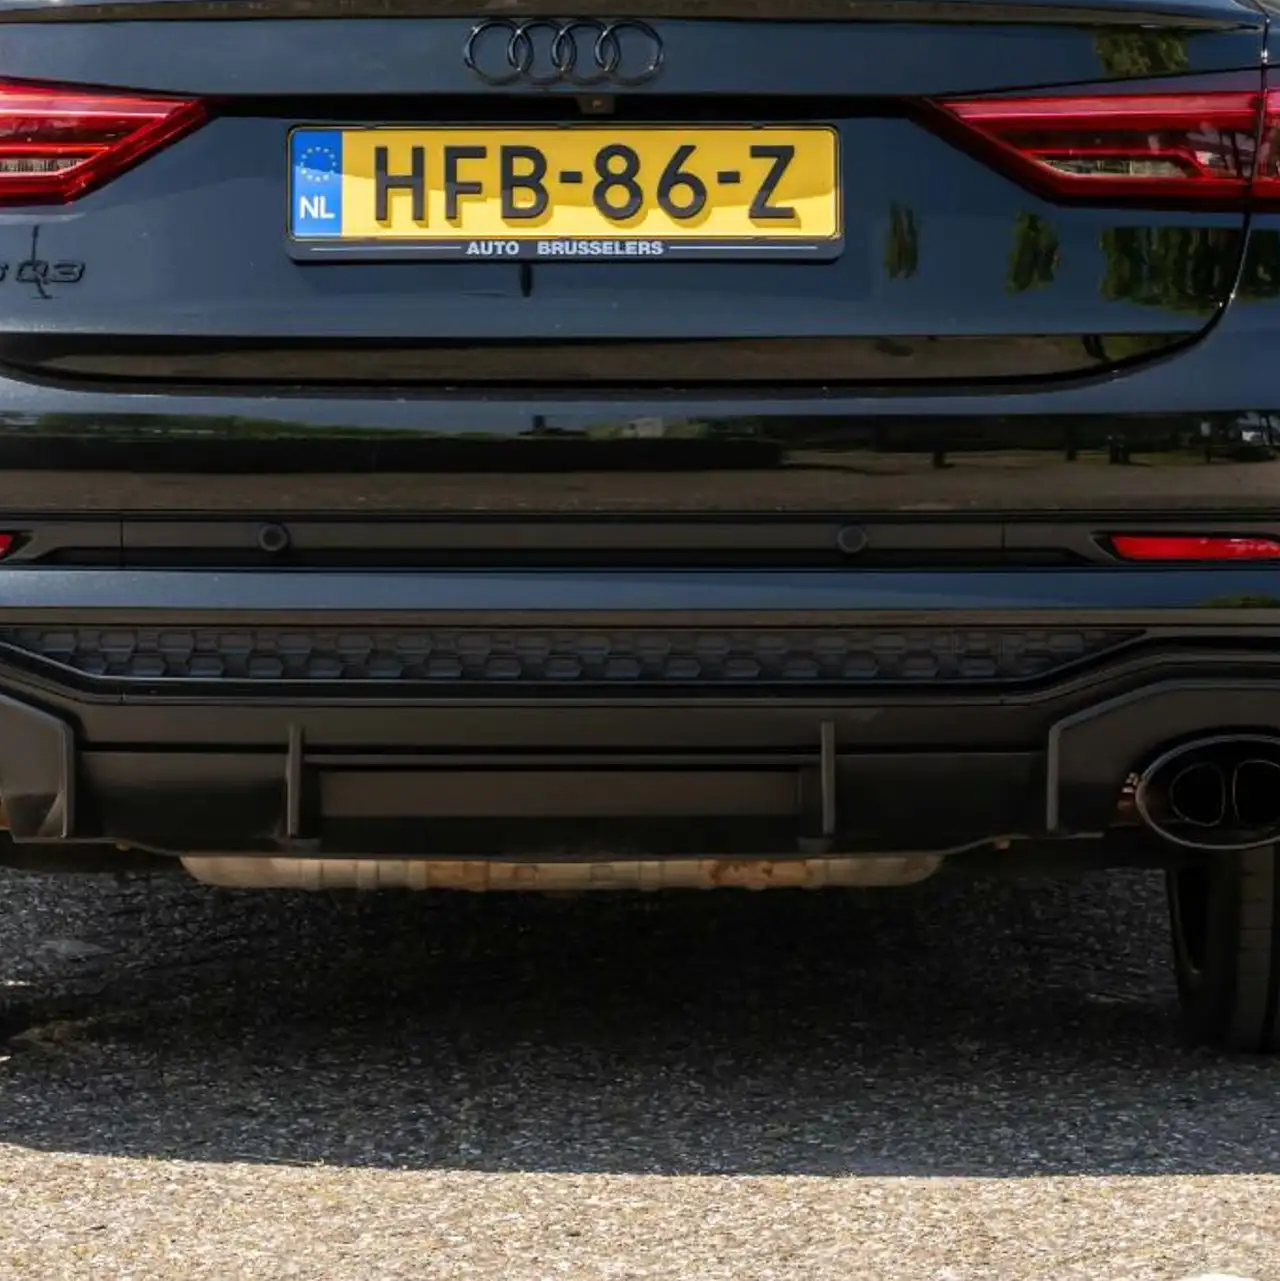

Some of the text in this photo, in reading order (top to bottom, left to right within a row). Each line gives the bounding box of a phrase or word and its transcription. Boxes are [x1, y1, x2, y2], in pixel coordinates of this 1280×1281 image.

[373, 144, 796, 220] HFB-86-Z
[300, 196, 335, 219] NL
[466, 241, 664, 255] AUTO BRUSSELERS
